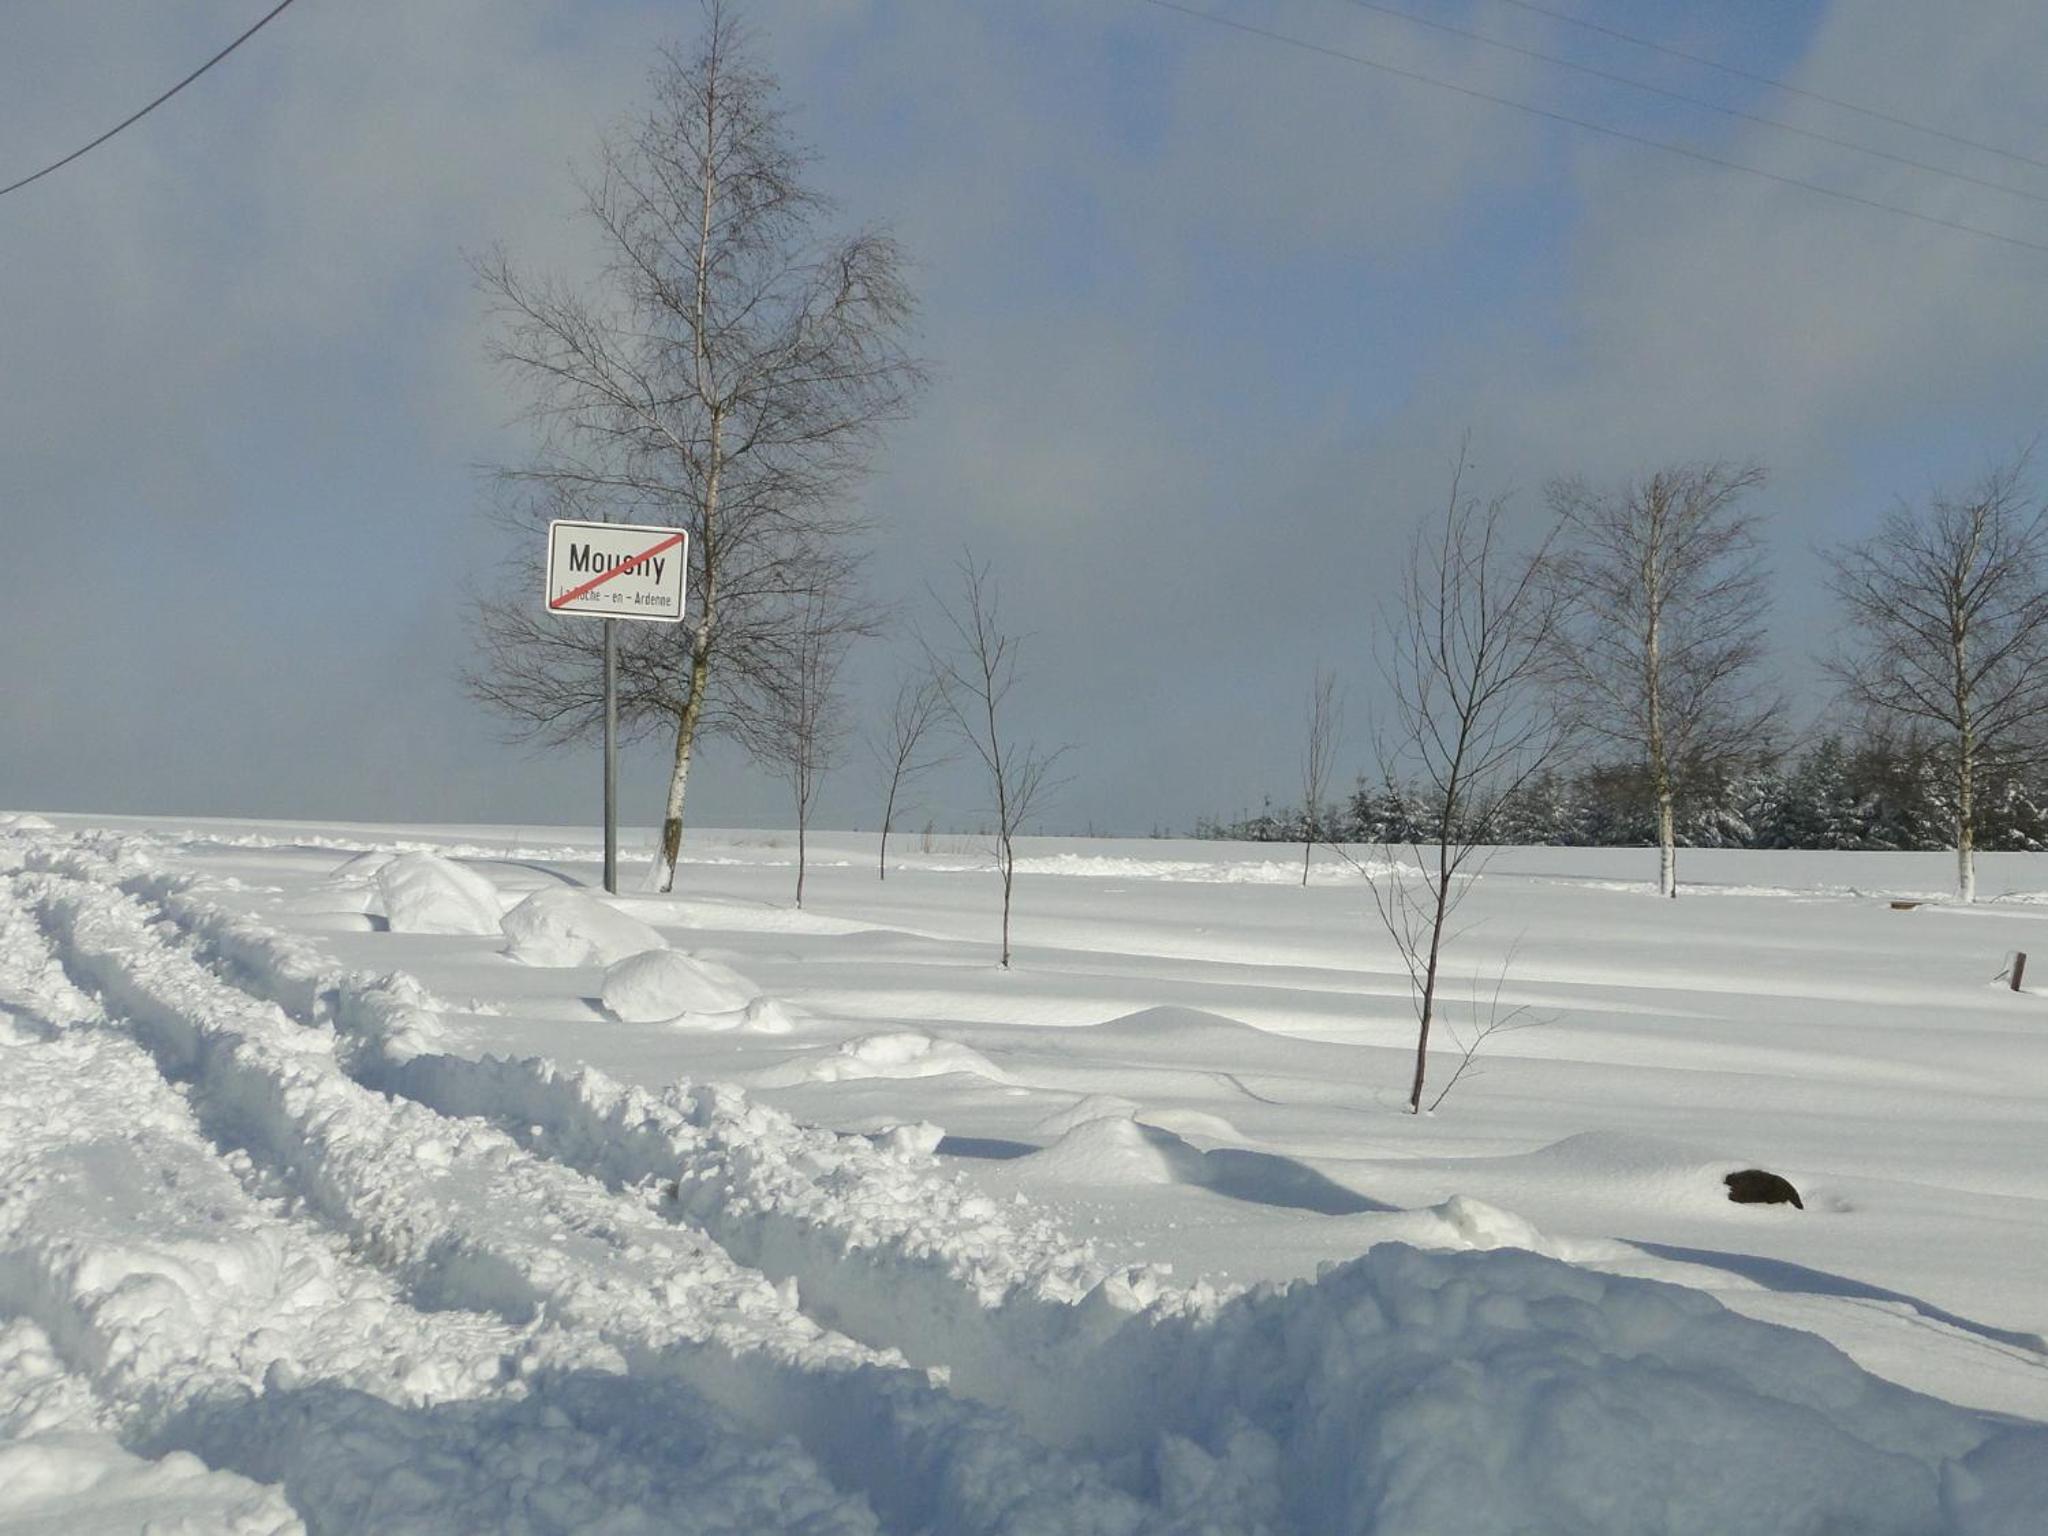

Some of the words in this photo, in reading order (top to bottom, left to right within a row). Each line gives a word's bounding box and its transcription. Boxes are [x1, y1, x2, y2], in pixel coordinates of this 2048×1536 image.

[569, 543, 666, 585] Mousny
[574, 587, 601, 601] oche
[634, 591, 672, 607] Ardenne
